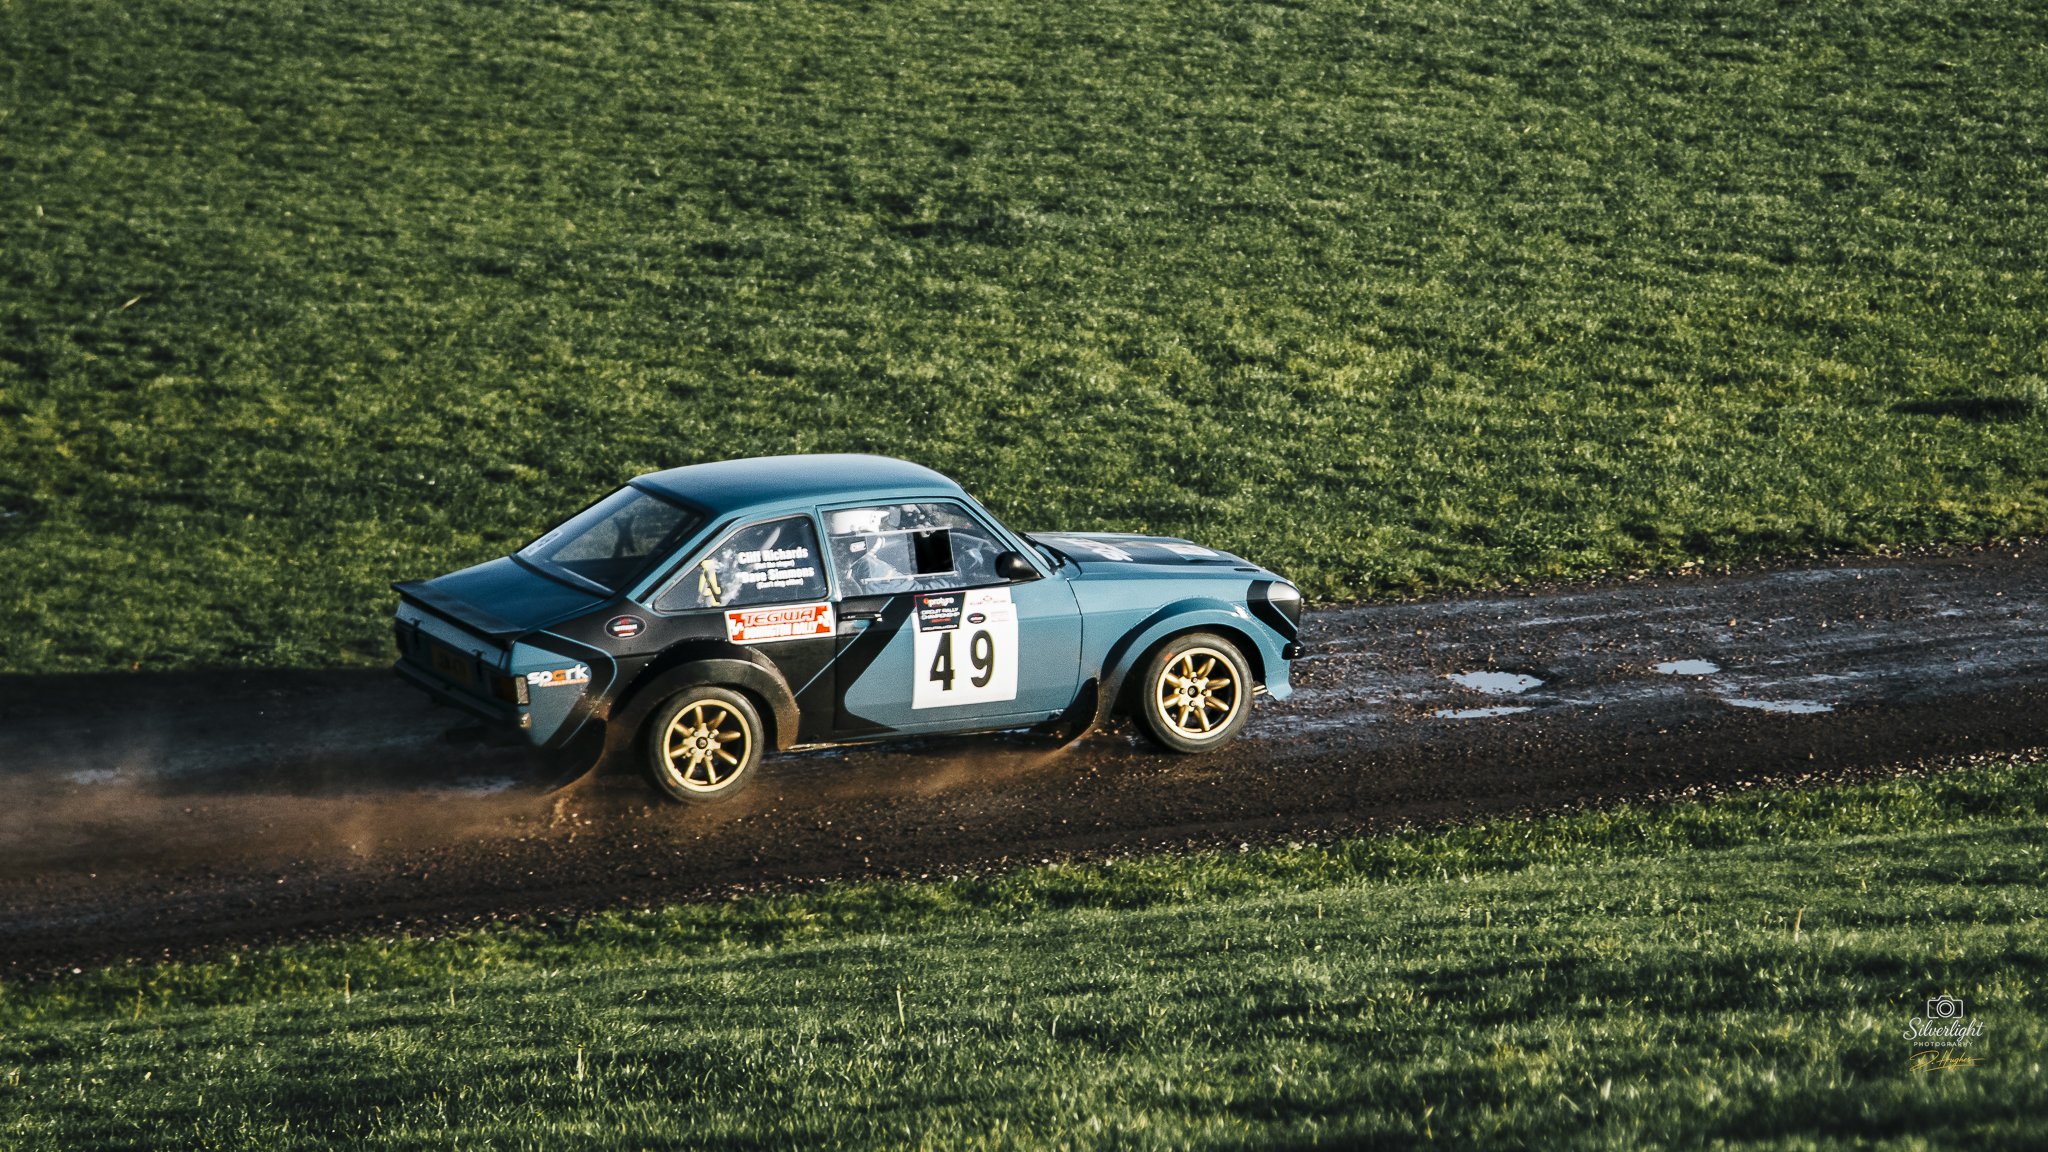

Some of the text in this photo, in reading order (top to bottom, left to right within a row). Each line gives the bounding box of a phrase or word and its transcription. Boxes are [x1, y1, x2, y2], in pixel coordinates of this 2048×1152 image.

[762, 546, 809, 562] Richards
[767, 566, 815, 581] Simmons
[741, 608, 816, 627] TEGIWA
[930, 629, 994, 691] 49
